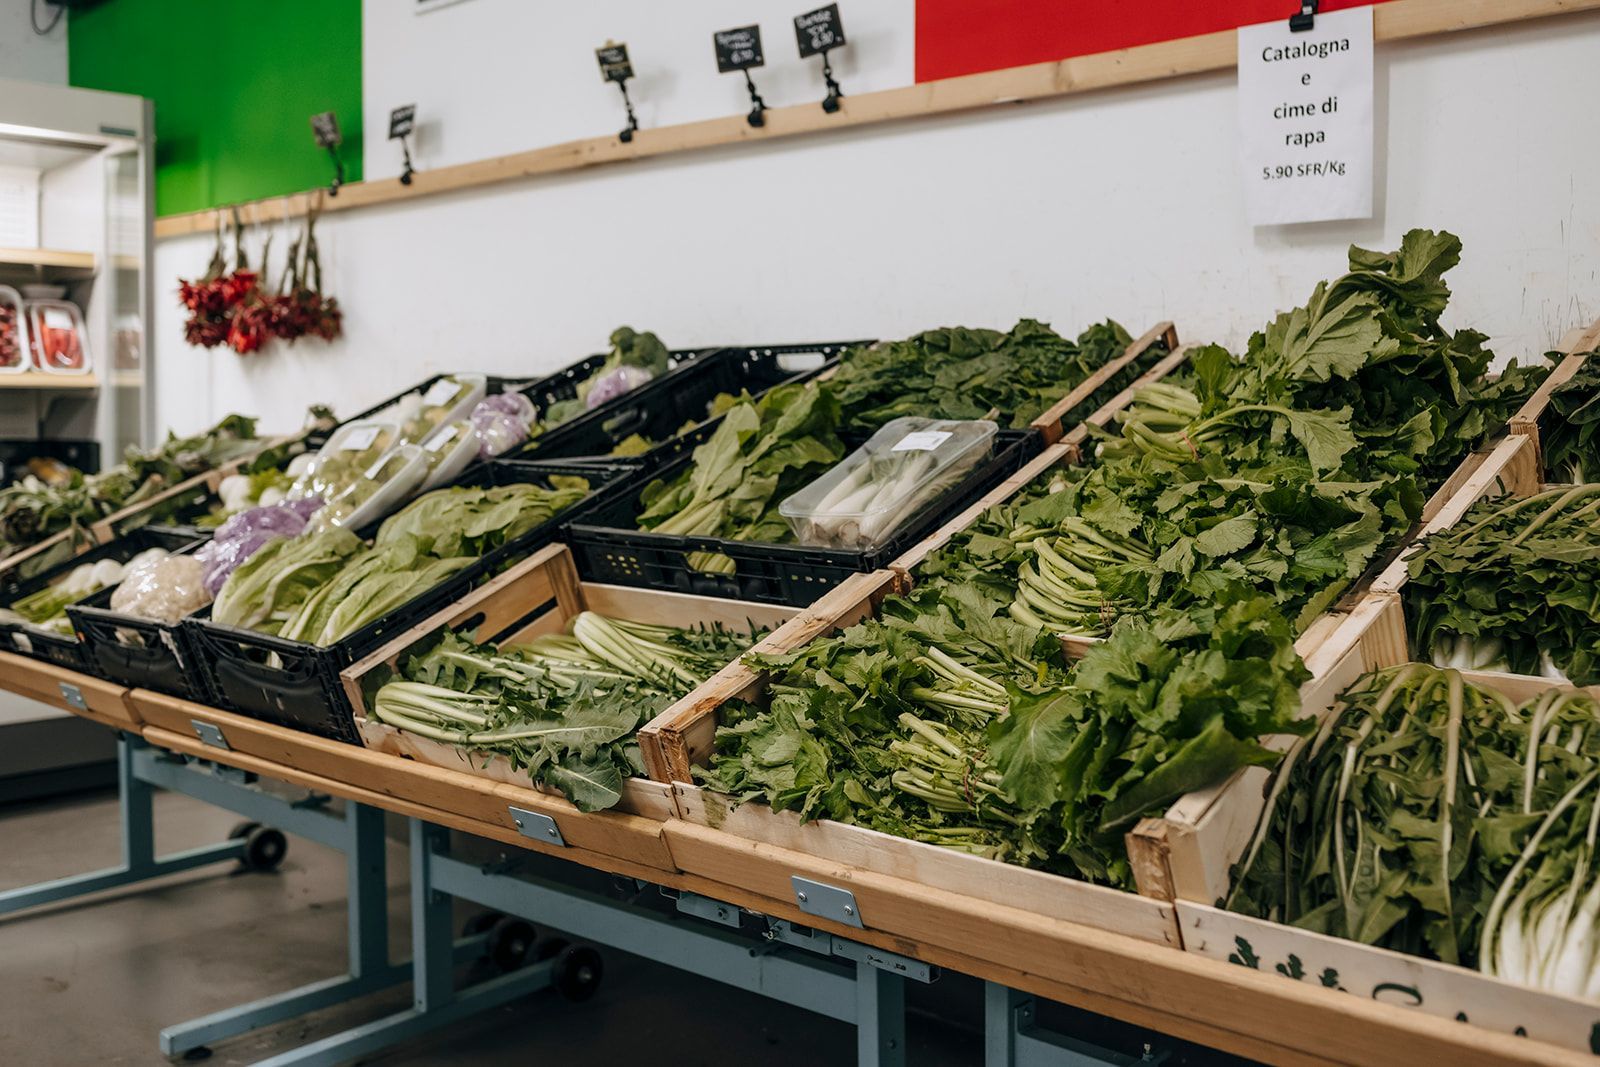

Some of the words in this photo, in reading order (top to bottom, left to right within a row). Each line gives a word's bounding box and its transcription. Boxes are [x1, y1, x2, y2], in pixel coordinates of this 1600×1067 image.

[1262, 38, 1350, 62] Catalogna
[1301, 73, 1311, 86] e
[1273, 102, 1316, 119] cime
[1321, 96, 1338, 114] di
[1285, 130, 1326, 148] rapa
[1263, 165, 1293, 180] 5.90
[1297, 160, 1346, 177] SFR/Kg
